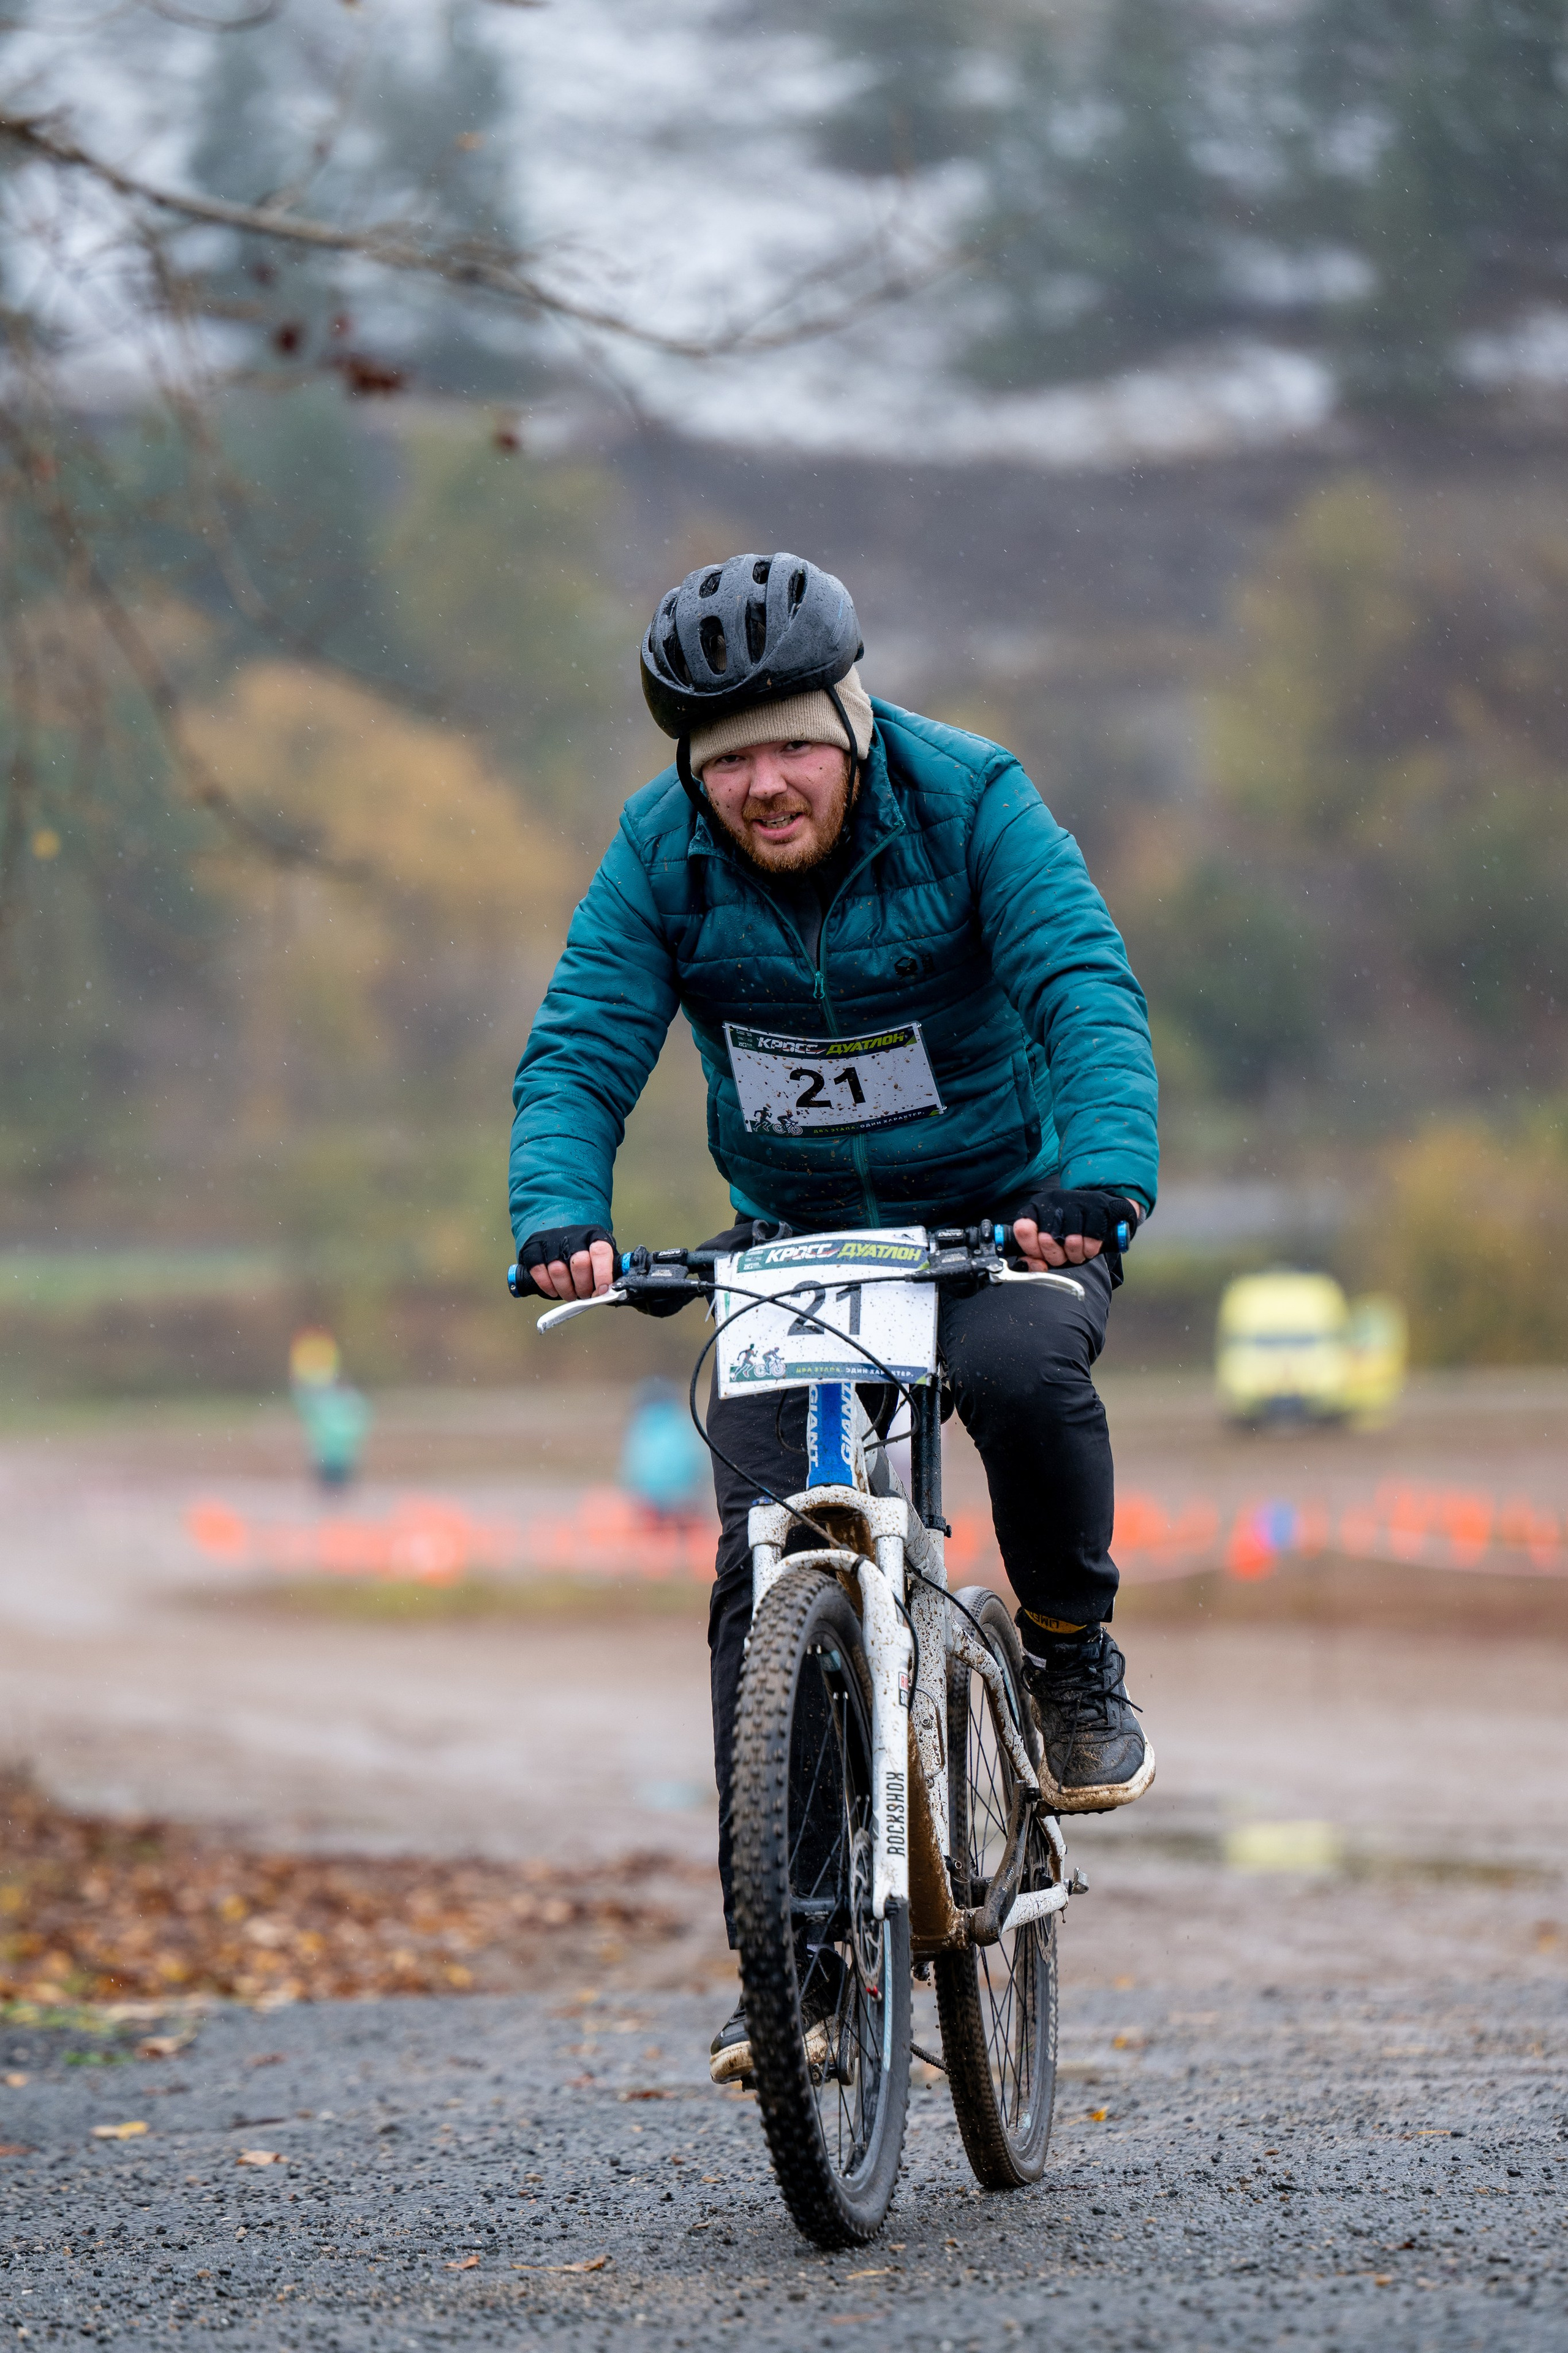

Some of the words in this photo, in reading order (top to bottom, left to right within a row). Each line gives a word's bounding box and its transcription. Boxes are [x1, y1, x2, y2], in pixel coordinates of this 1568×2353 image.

[757, 1037, 826, 1055] КРОСС
[826, 1032, 905, 1056] ДУАТЛОН
[790, 1067, 866, 1108] 21
[860, 1120, 881, 1129] ОДИН
[883, 1111, 925, 1124] ХАРАКТЕР.
[765, 1243, 840, 1264] КРОСС
[837, 1242, 921, 1261] ДУАТЛОН
[787, 1280, 862, 1336] 21
[869, 1369, 914, 1377] ХАРКТЕР.
[809, 1383, 819, 1468] GIANT
[841, 1383, 852, 1465] GIANT
[886, 1772, 905, 1857] ROCKSHOX
